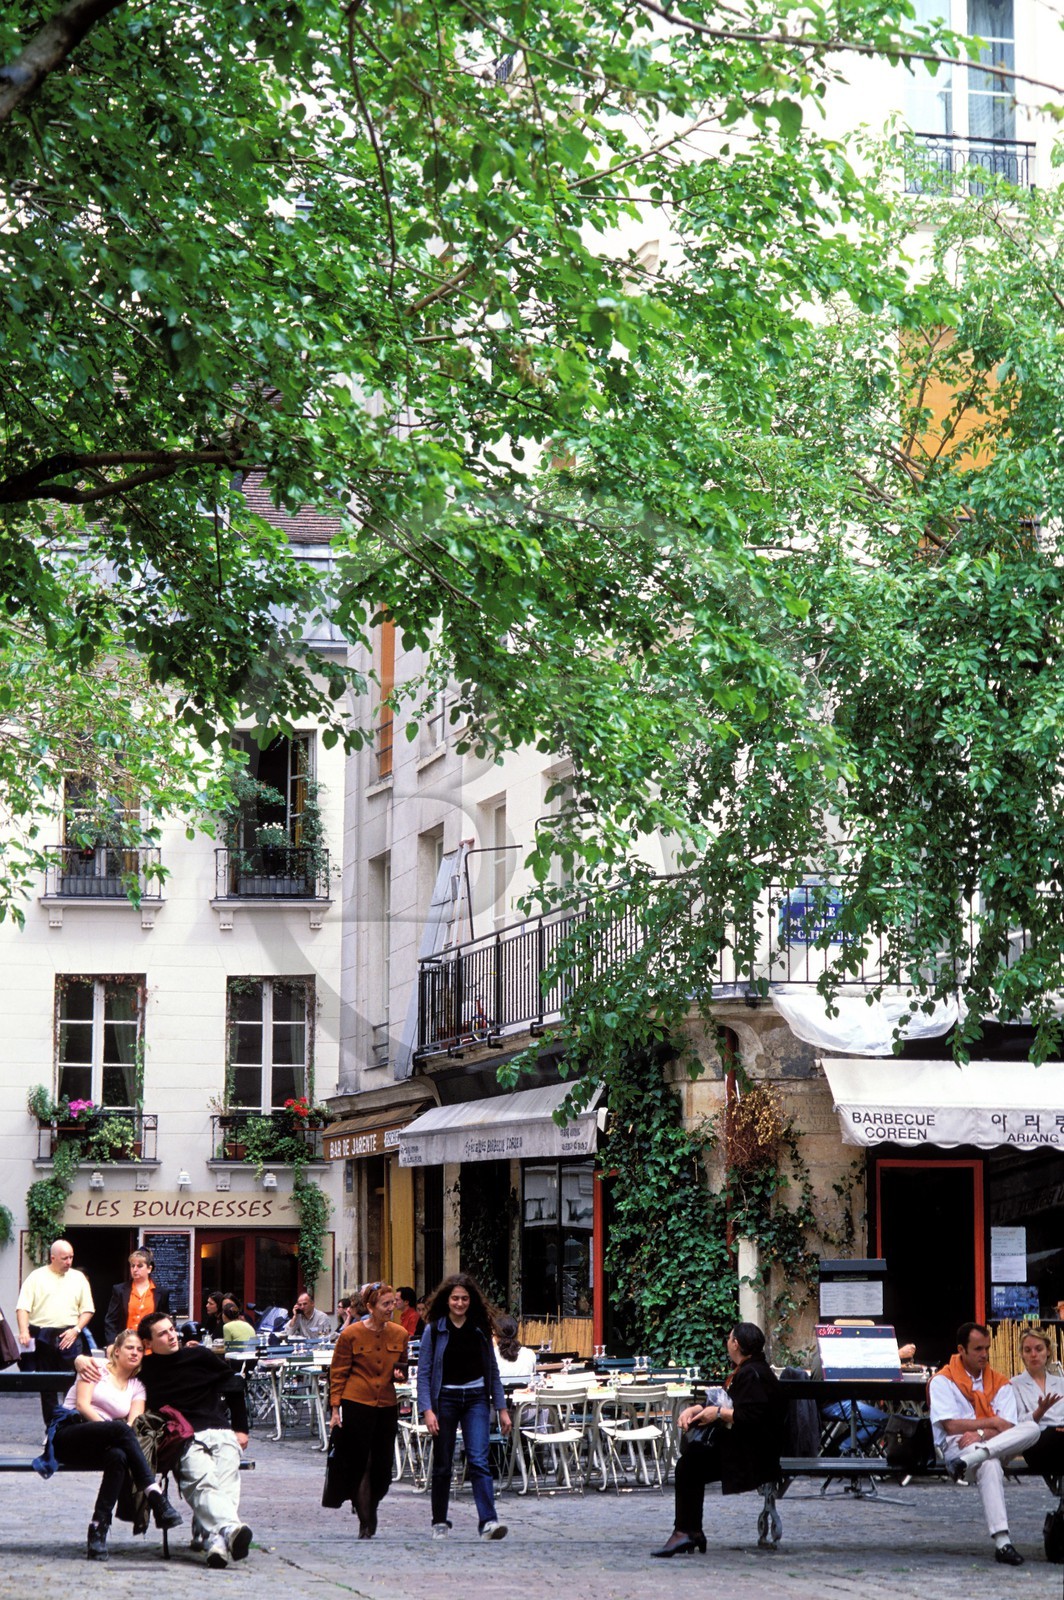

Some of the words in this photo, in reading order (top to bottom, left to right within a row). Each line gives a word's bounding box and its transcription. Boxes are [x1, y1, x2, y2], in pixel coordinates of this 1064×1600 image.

[852, 1112, 936, 1126] BARBECUE
[330, 1140, 342, 1158] BAR
[342, 1138, 350, 1156] DE
[352, 1133, 377, 1155] JARENTE
[1007, 1132, 1059, 1143] ARIANG
[85, 1200, 121, 1217] LES
[133, 1200, 273, 1220] BOUGRESSES
